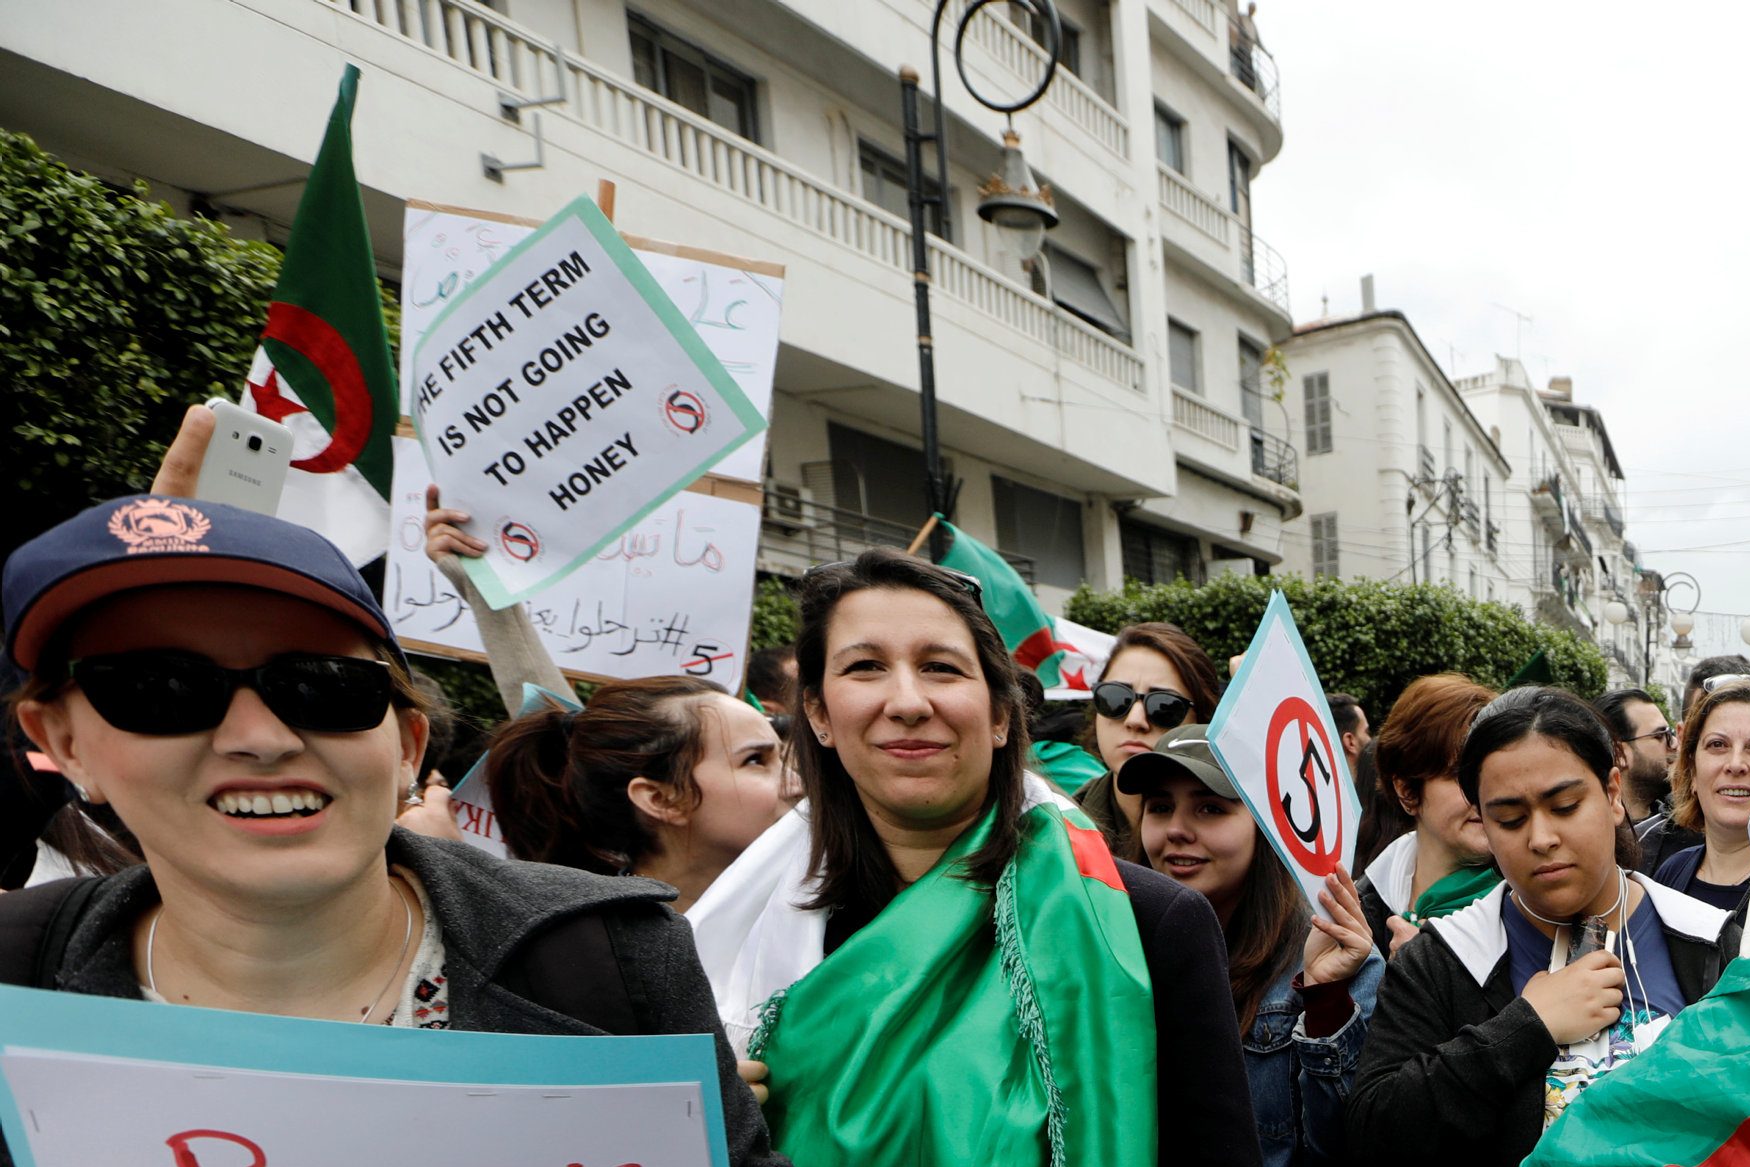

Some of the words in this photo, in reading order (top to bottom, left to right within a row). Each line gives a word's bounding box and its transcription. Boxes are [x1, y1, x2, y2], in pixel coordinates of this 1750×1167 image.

[417, 373, 443, 415] HE
[439, 310, 515, 382] FIFTH
[508, 250, 592, 319] TERM
[437, 424, 466, 456] IS
[463, 378, 521, 433] NOT
[521, 312, 611, 388] GOING
[483, 451, 526, 486] TO
[523, 368, 633, 458] HAPPEN
[549, 432, 639, 511] HONEY
[685, 644, 719, 676] 5
[1282, 737, 1331, 843] 5
